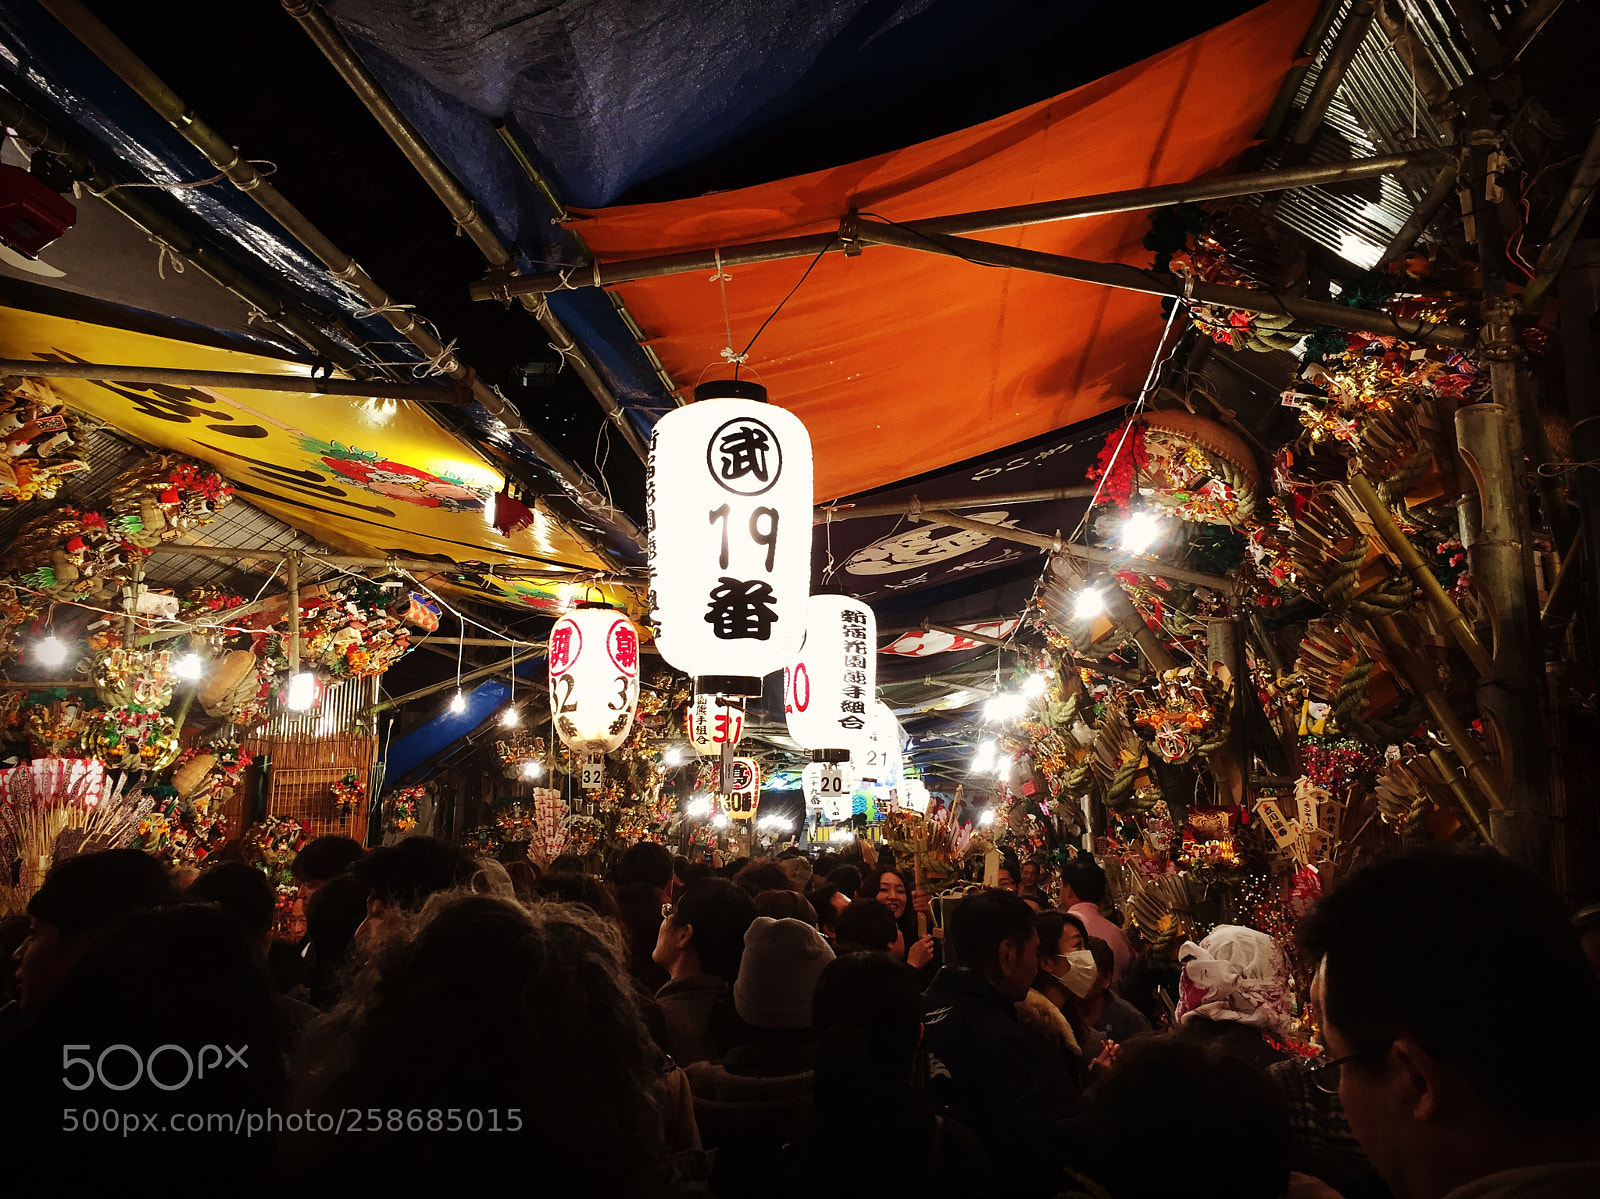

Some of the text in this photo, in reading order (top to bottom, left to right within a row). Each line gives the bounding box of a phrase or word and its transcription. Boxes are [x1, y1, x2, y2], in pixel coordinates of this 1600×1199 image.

[718, 425, 770, 483] 武
[708, 503, 780, 573] 19
[704, 576, 779, 641] 番
[583, 769, 602, 784] 32
[866, 750, 888, 766] 21
[820, 776, 842, 792] 20
